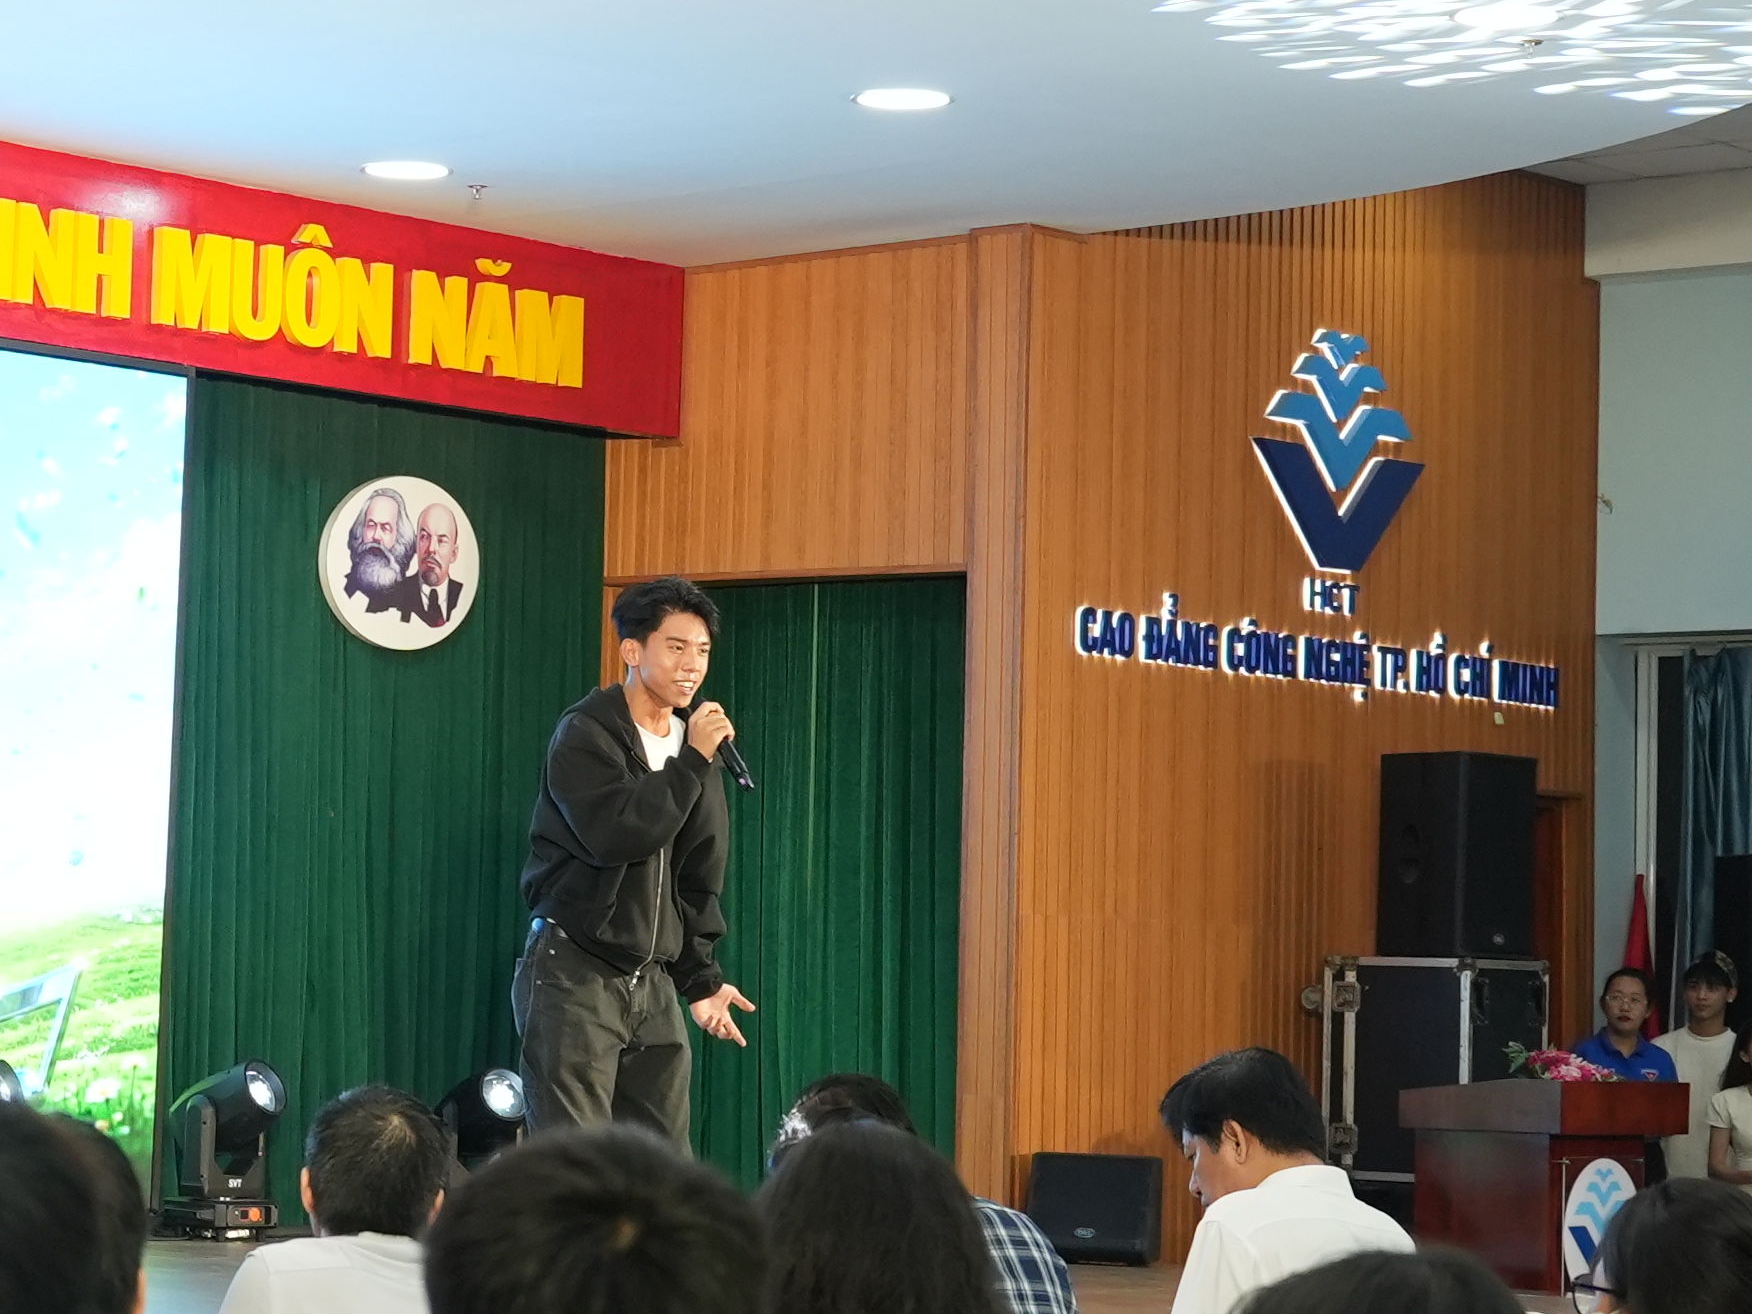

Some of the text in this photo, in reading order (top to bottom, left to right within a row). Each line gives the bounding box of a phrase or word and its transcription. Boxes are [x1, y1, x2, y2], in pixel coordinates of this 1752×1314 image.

[152, 224, 393, 362] MUÔN
[408, 258, 585, 389] NĂM
[1303, 577, 1360, 616] HCT
[1076, 593, 1560, 709] CAO ĐẲNG CÔNG NGHỆ TP. HỒ CHÍ MINH
[228, 1178, 243, 1188] SVT
